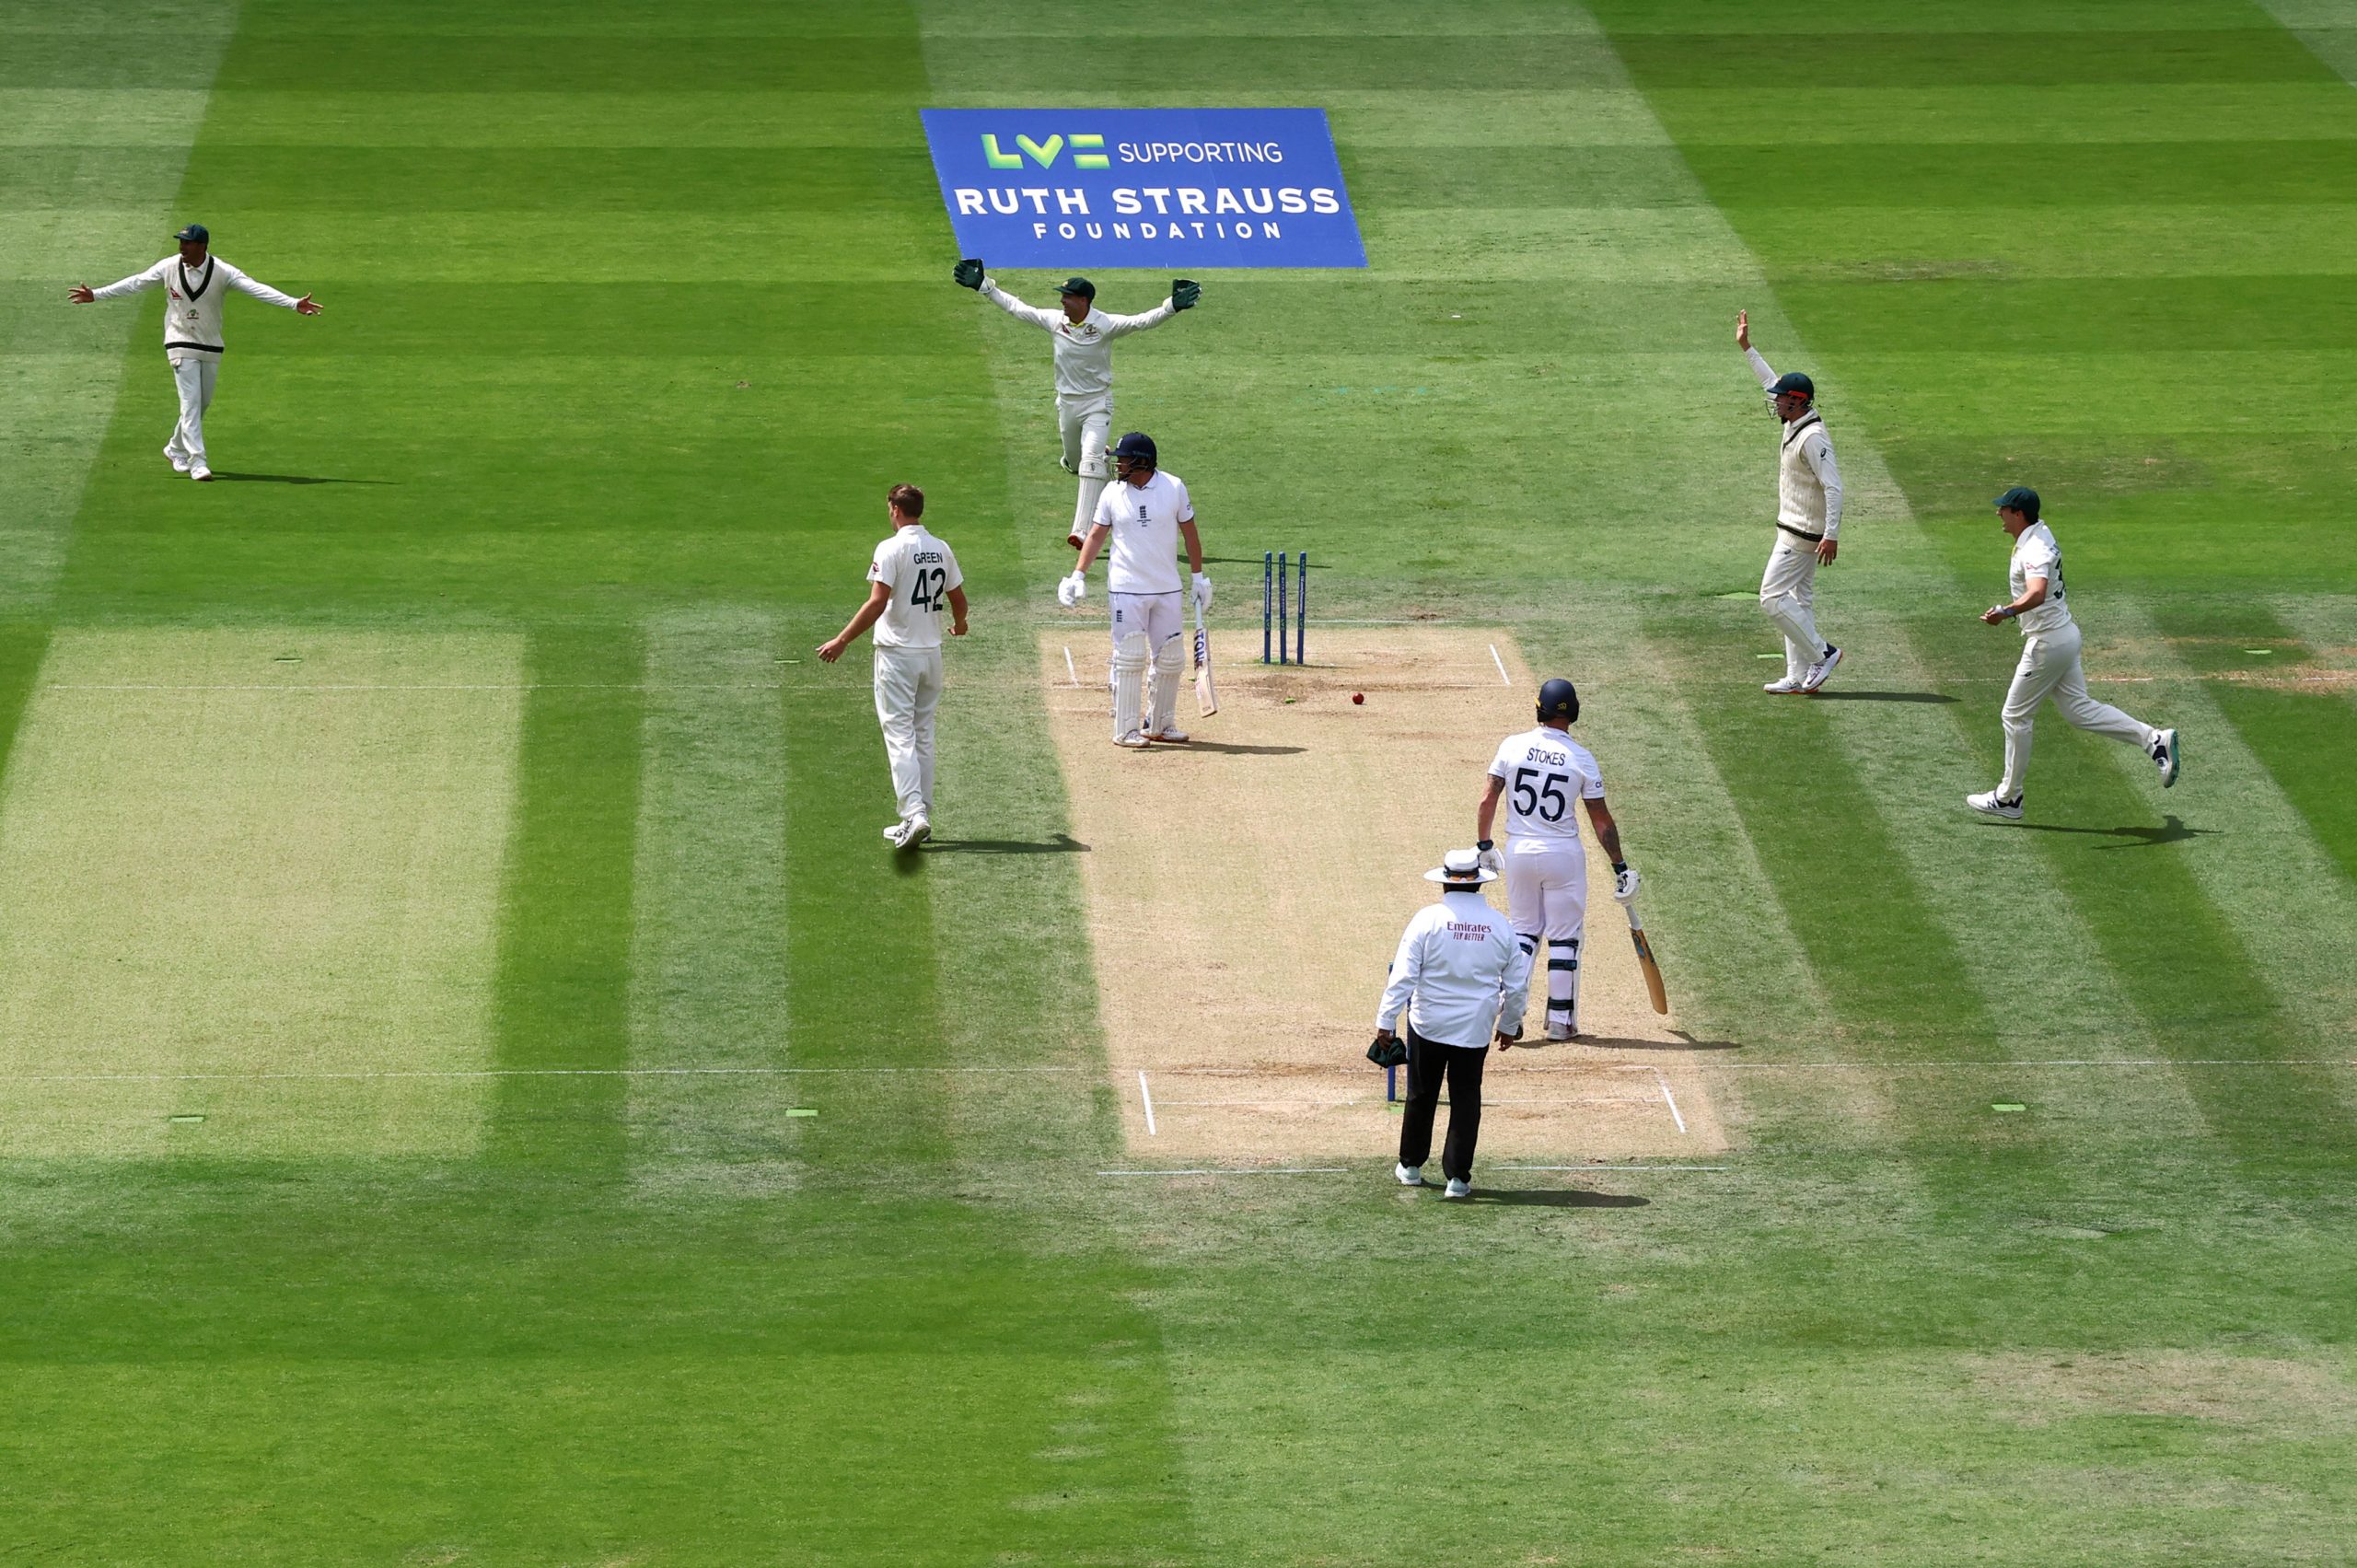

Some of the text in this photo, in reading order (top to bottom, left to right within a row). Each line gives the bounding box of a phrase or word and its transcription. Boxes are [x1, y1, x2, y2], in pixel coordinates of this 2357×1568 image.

[1118, 142, 1283, 164] SUPPORTING
[954, 187, 1340, 215] RUTH STRAUSS
[1033, 222, 1282, 239] FOUNDATION
[913, 552, 943, 564] GREEN
[911, 567, 946, 613] 42
[1527, 747, 1566, 767] STOKES
[1513, 767, 1570, 822] 55
[1446, 921, 1492, 933] Emirates
[1453, 932, 1485, 941] FLY BETTER
